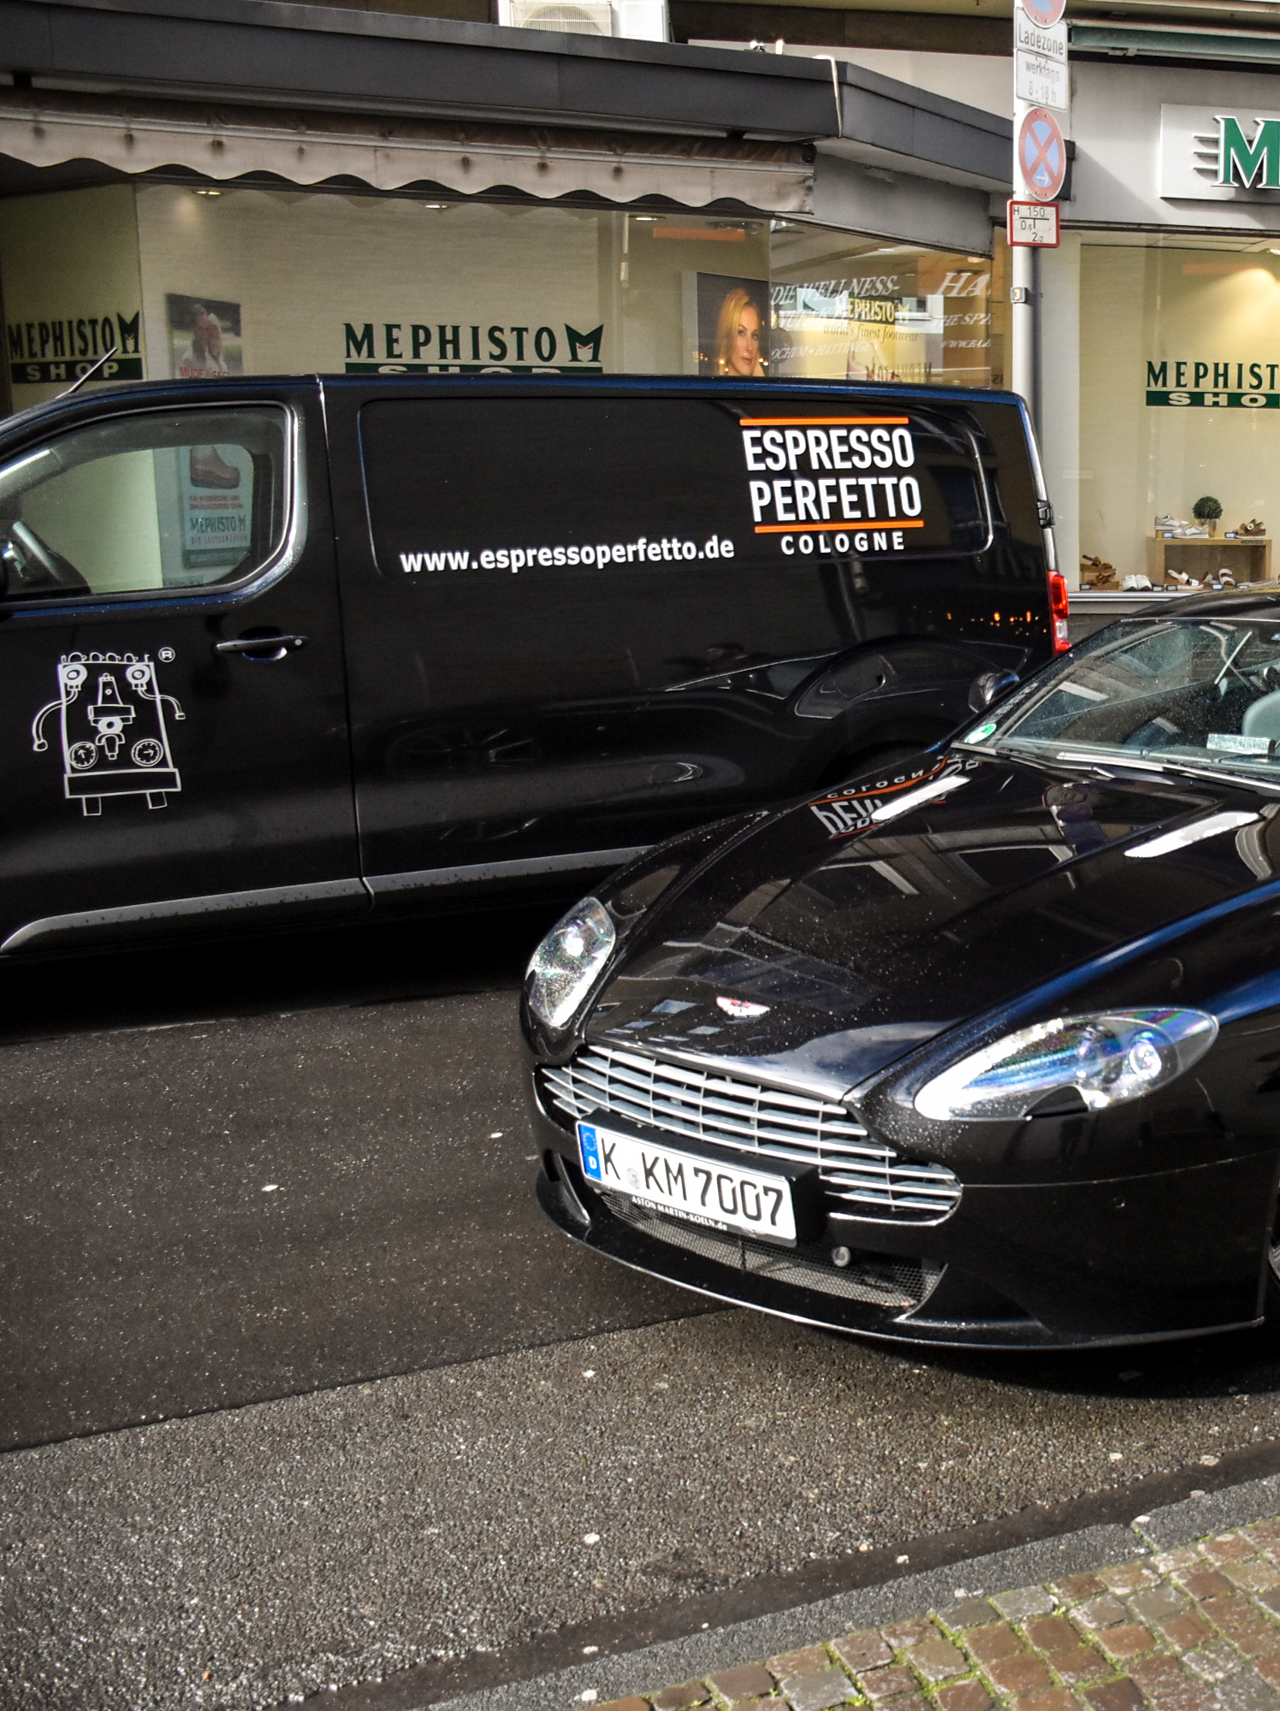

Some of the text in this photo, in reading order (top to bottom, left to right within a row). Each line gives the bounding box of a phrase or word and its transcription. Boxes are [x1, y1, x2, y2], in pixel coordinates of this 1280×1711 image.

[1018, 23, 1064, 56] Ladezone
[1025, 61, 1060, 84] werktags
[1013, 206, 1045, 217] H 150
[7, 316, 116, 361] MEPHISTO
[343, 323, 558, 363] MEPHISTO
[26, 361, 120, 382] SHOP
[742, 427, 915, 472] ESPRESSO
[749, 476, 923, 522] PERFETTO
[400, 535, 735, 574] www.espressoperfetto.de
[780, 531, 905, 555] COLOGNE
[588, 1156, 598, 1170] D
[601, 1138, 621, 1180] K
[693, 1166, 784, 1227] 7007
[632, 1195, 728, 1231] ASTON MARTIN-KOELN.de
